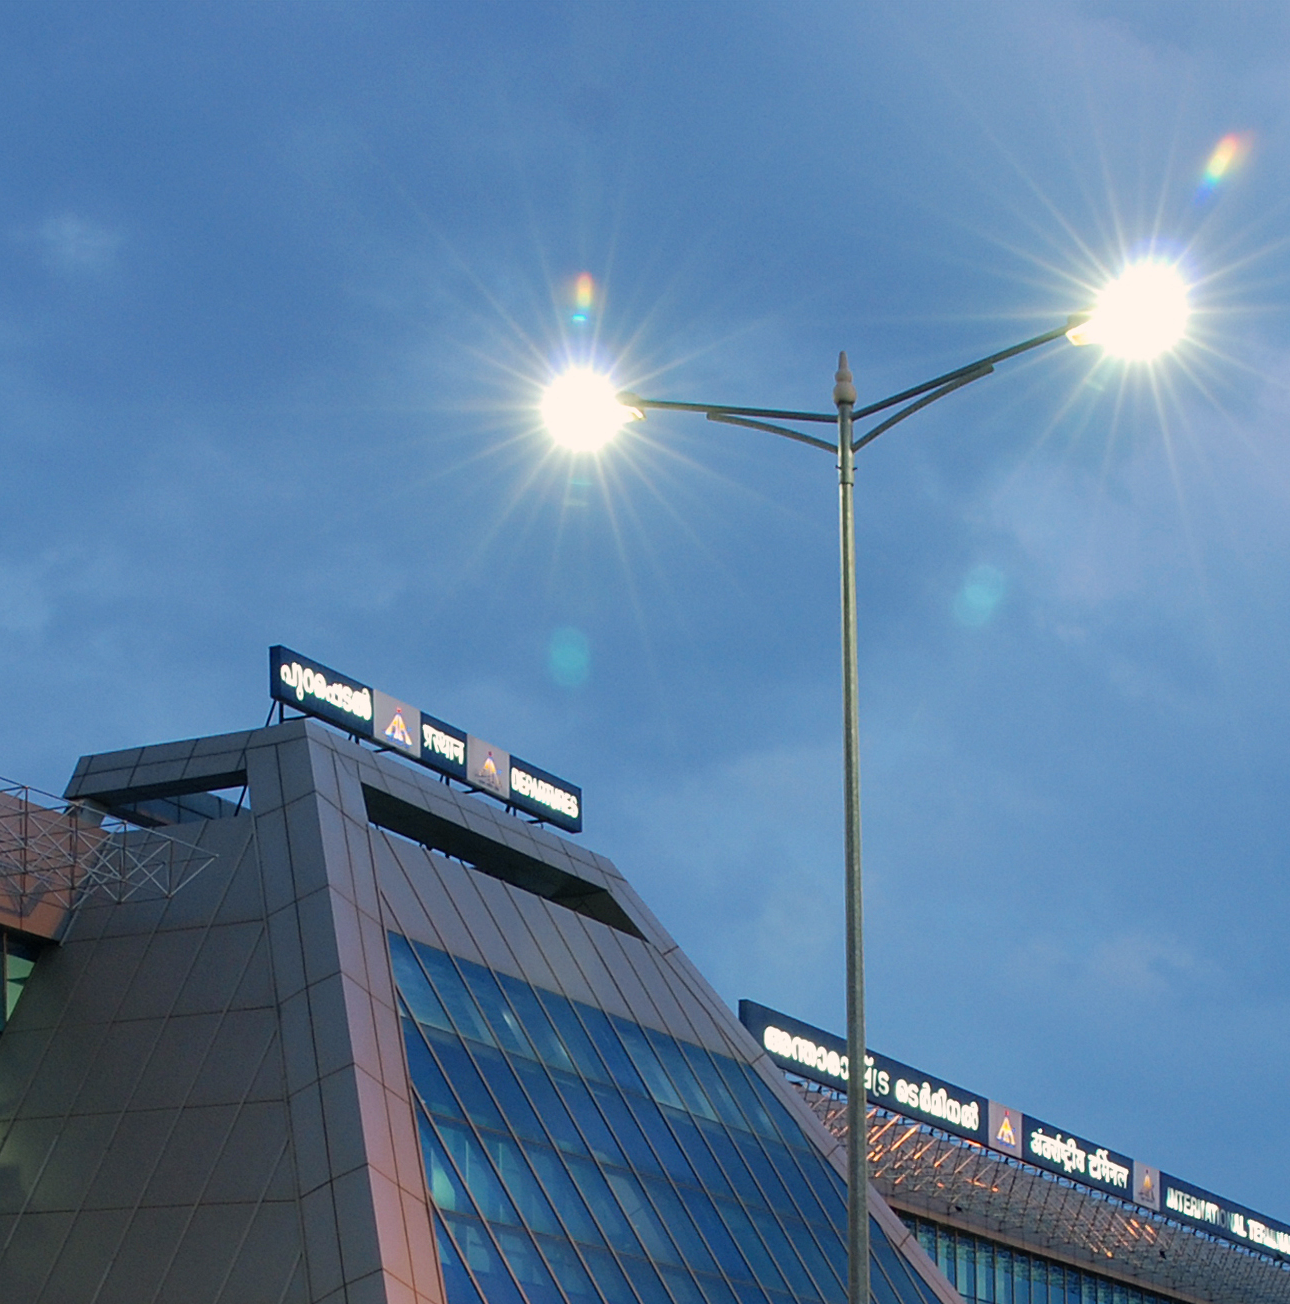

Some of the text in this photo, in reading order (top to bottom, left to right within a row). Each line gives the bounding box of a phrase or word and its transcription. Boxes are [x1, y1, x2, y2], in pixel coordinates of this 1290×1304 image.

[422, 723, 465, 765] प्रस्थान
[510, 767, 579, 819] DEPARTURES
[1166, 1187, 1247, 1238] INTERNATIONAL
